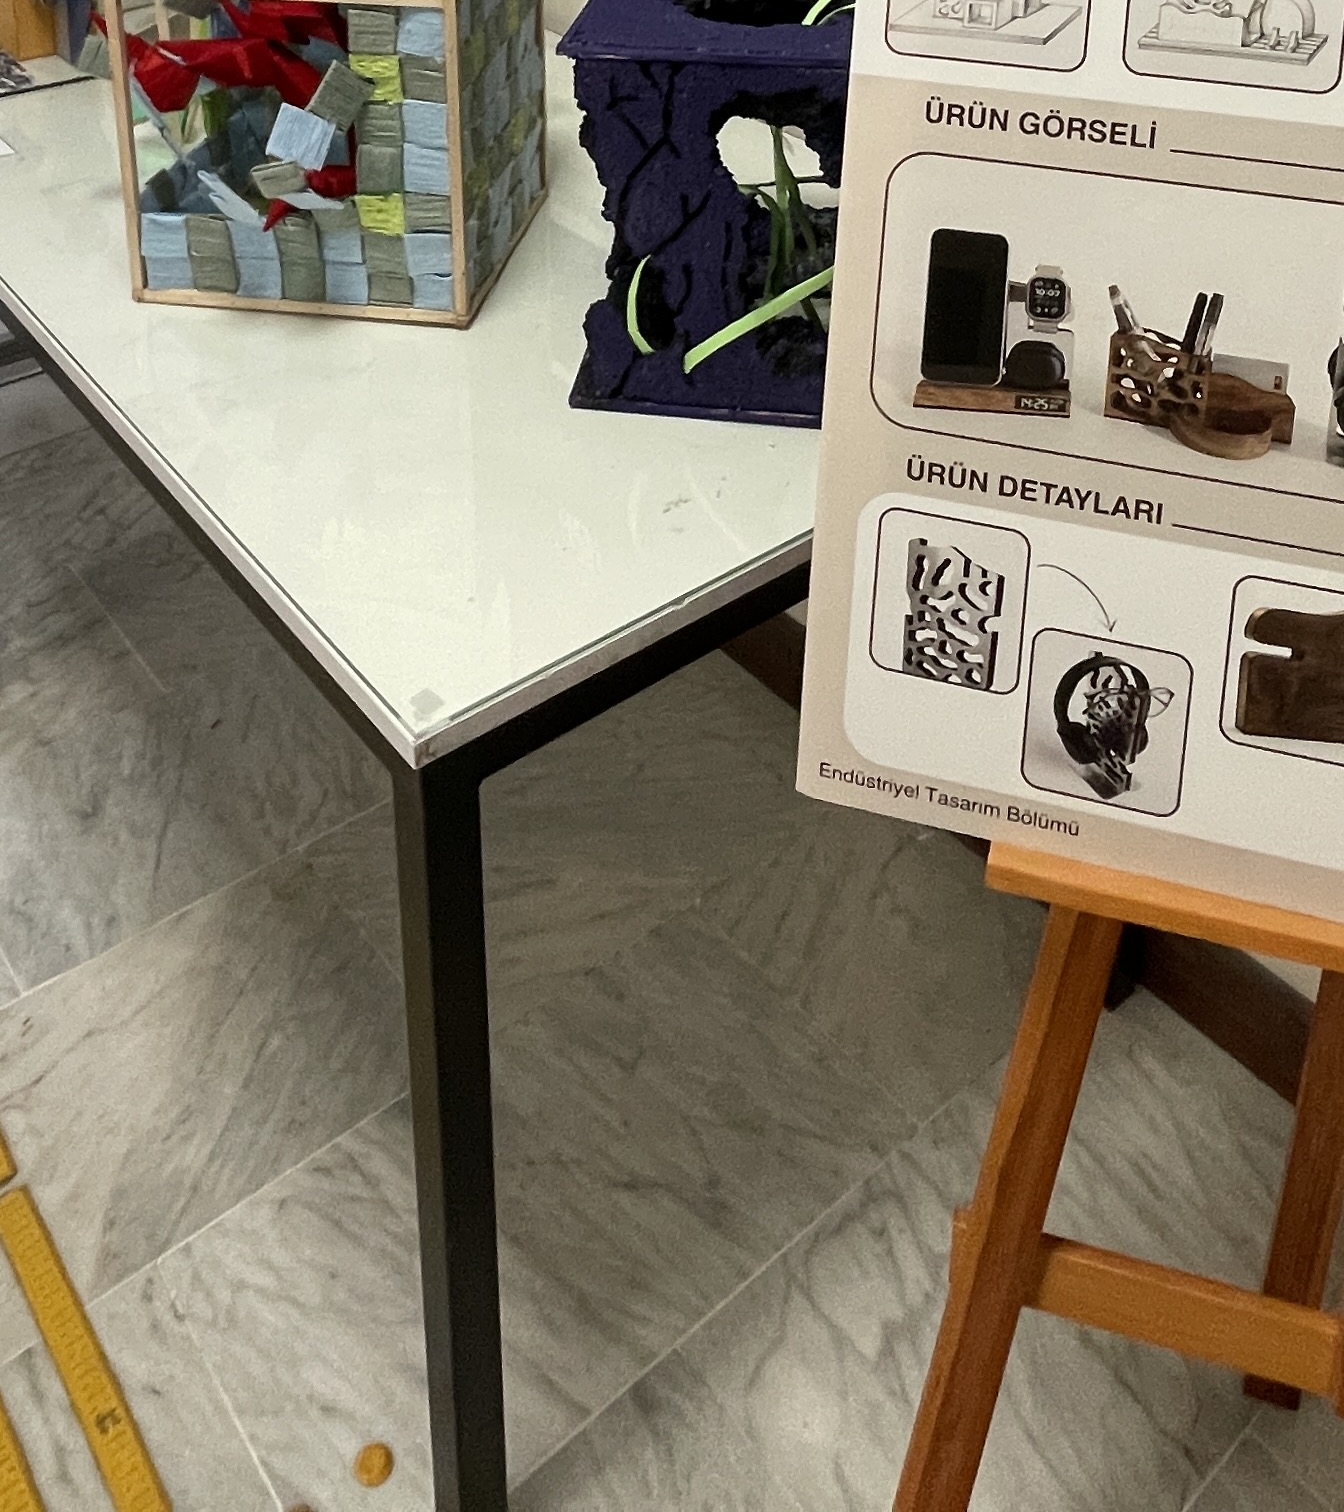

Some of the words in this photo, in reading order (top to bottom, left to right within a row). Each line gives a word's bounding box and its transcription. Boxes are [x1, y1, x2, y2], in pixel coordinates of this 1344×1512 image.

[924, 96, 1010, 132] ÜRÜN
[1018, 100, 1158, 149] GÖRSELİ
[906, 454, 989, 493] ÜRÜN
[998, 475, 1164, 525] DETAYLARI
[819, 762, 920, 799] Endüstriyel
[925, 786, 1001, 819] Tasarım
[1007, 805, 1080, 837] Bölümü
